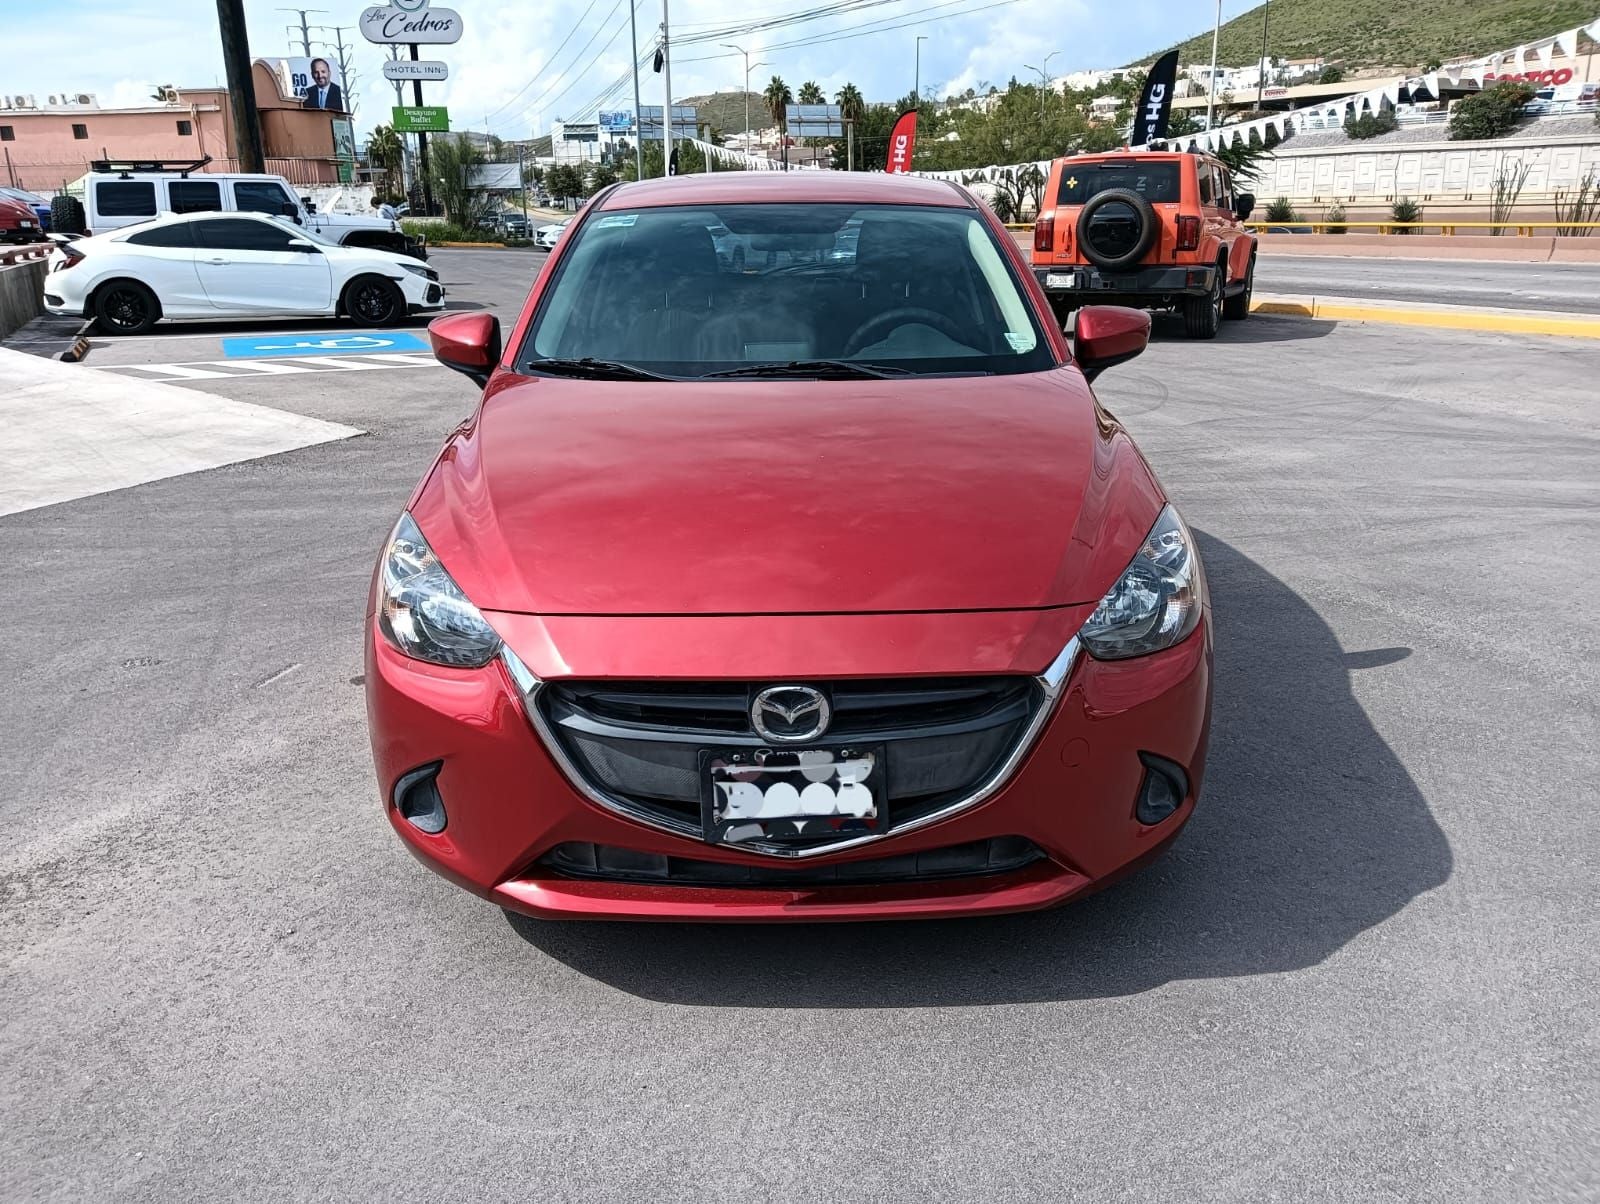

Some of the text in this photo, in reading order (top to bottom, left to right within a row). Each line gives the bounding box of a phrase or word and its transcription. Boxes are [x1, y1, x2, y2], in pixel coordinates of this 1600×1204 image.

[366, 8, 387, 23] Los
[382, 12, 454, 38] Cedros
[292, 73, 308, 87] GO
[1145, 83, 1166, 121] HG
[893, 135, 908, 163] HG
